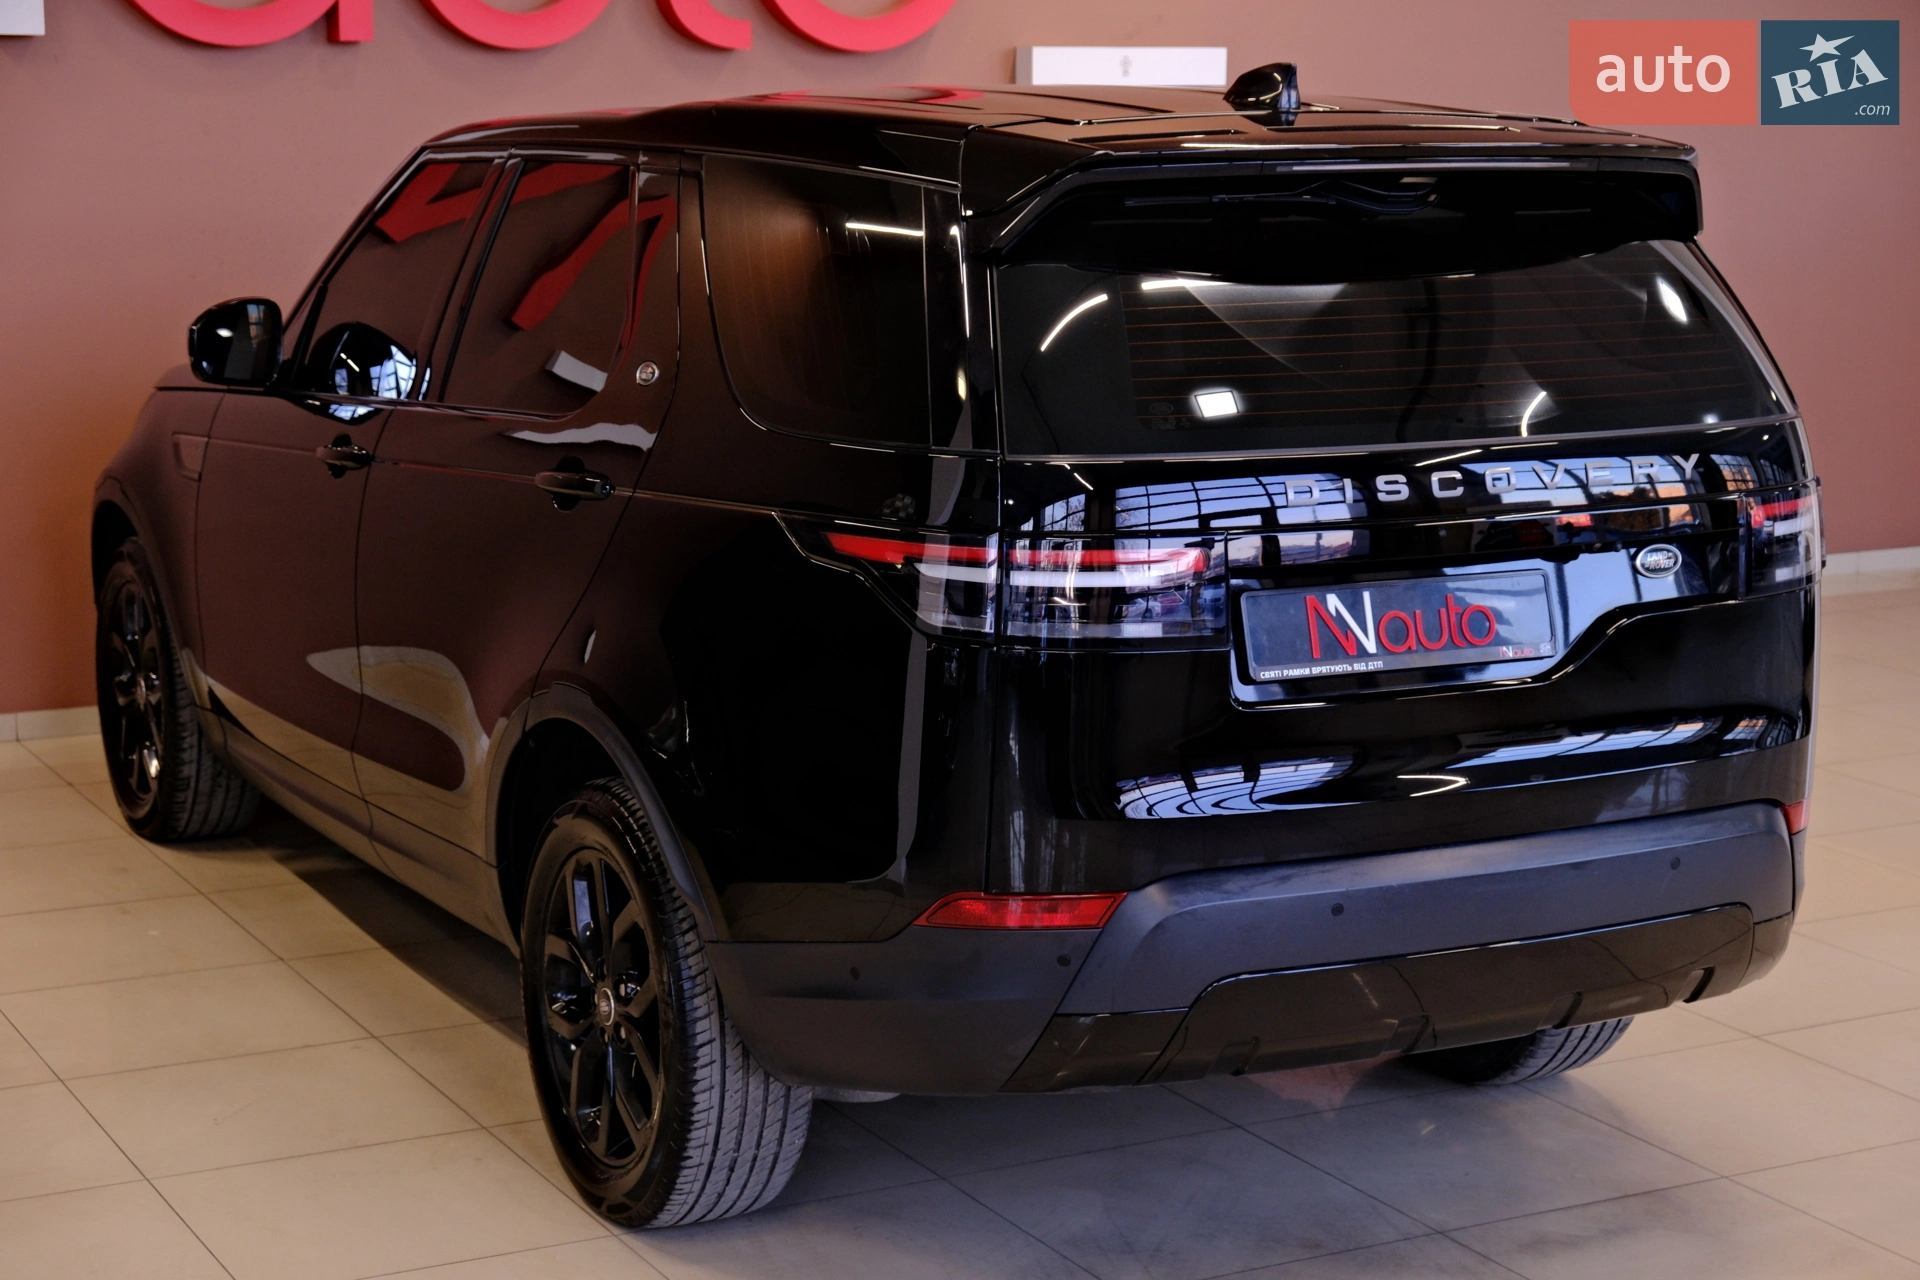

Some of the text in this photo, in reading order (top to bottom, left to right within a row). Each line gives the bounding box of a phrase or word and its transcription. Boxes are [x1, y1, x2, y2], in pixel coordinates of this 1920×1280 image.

[1284, 453, 1700, 506] DISCOVERY
[1647, 550, 1668, 561] LAND
[1649, 558, 1675, 570] ROVER
[1260, 660, 1384, 679] СВЯТІ РАМКИ ВРЯТУЮТЬ ВІД ДТП
